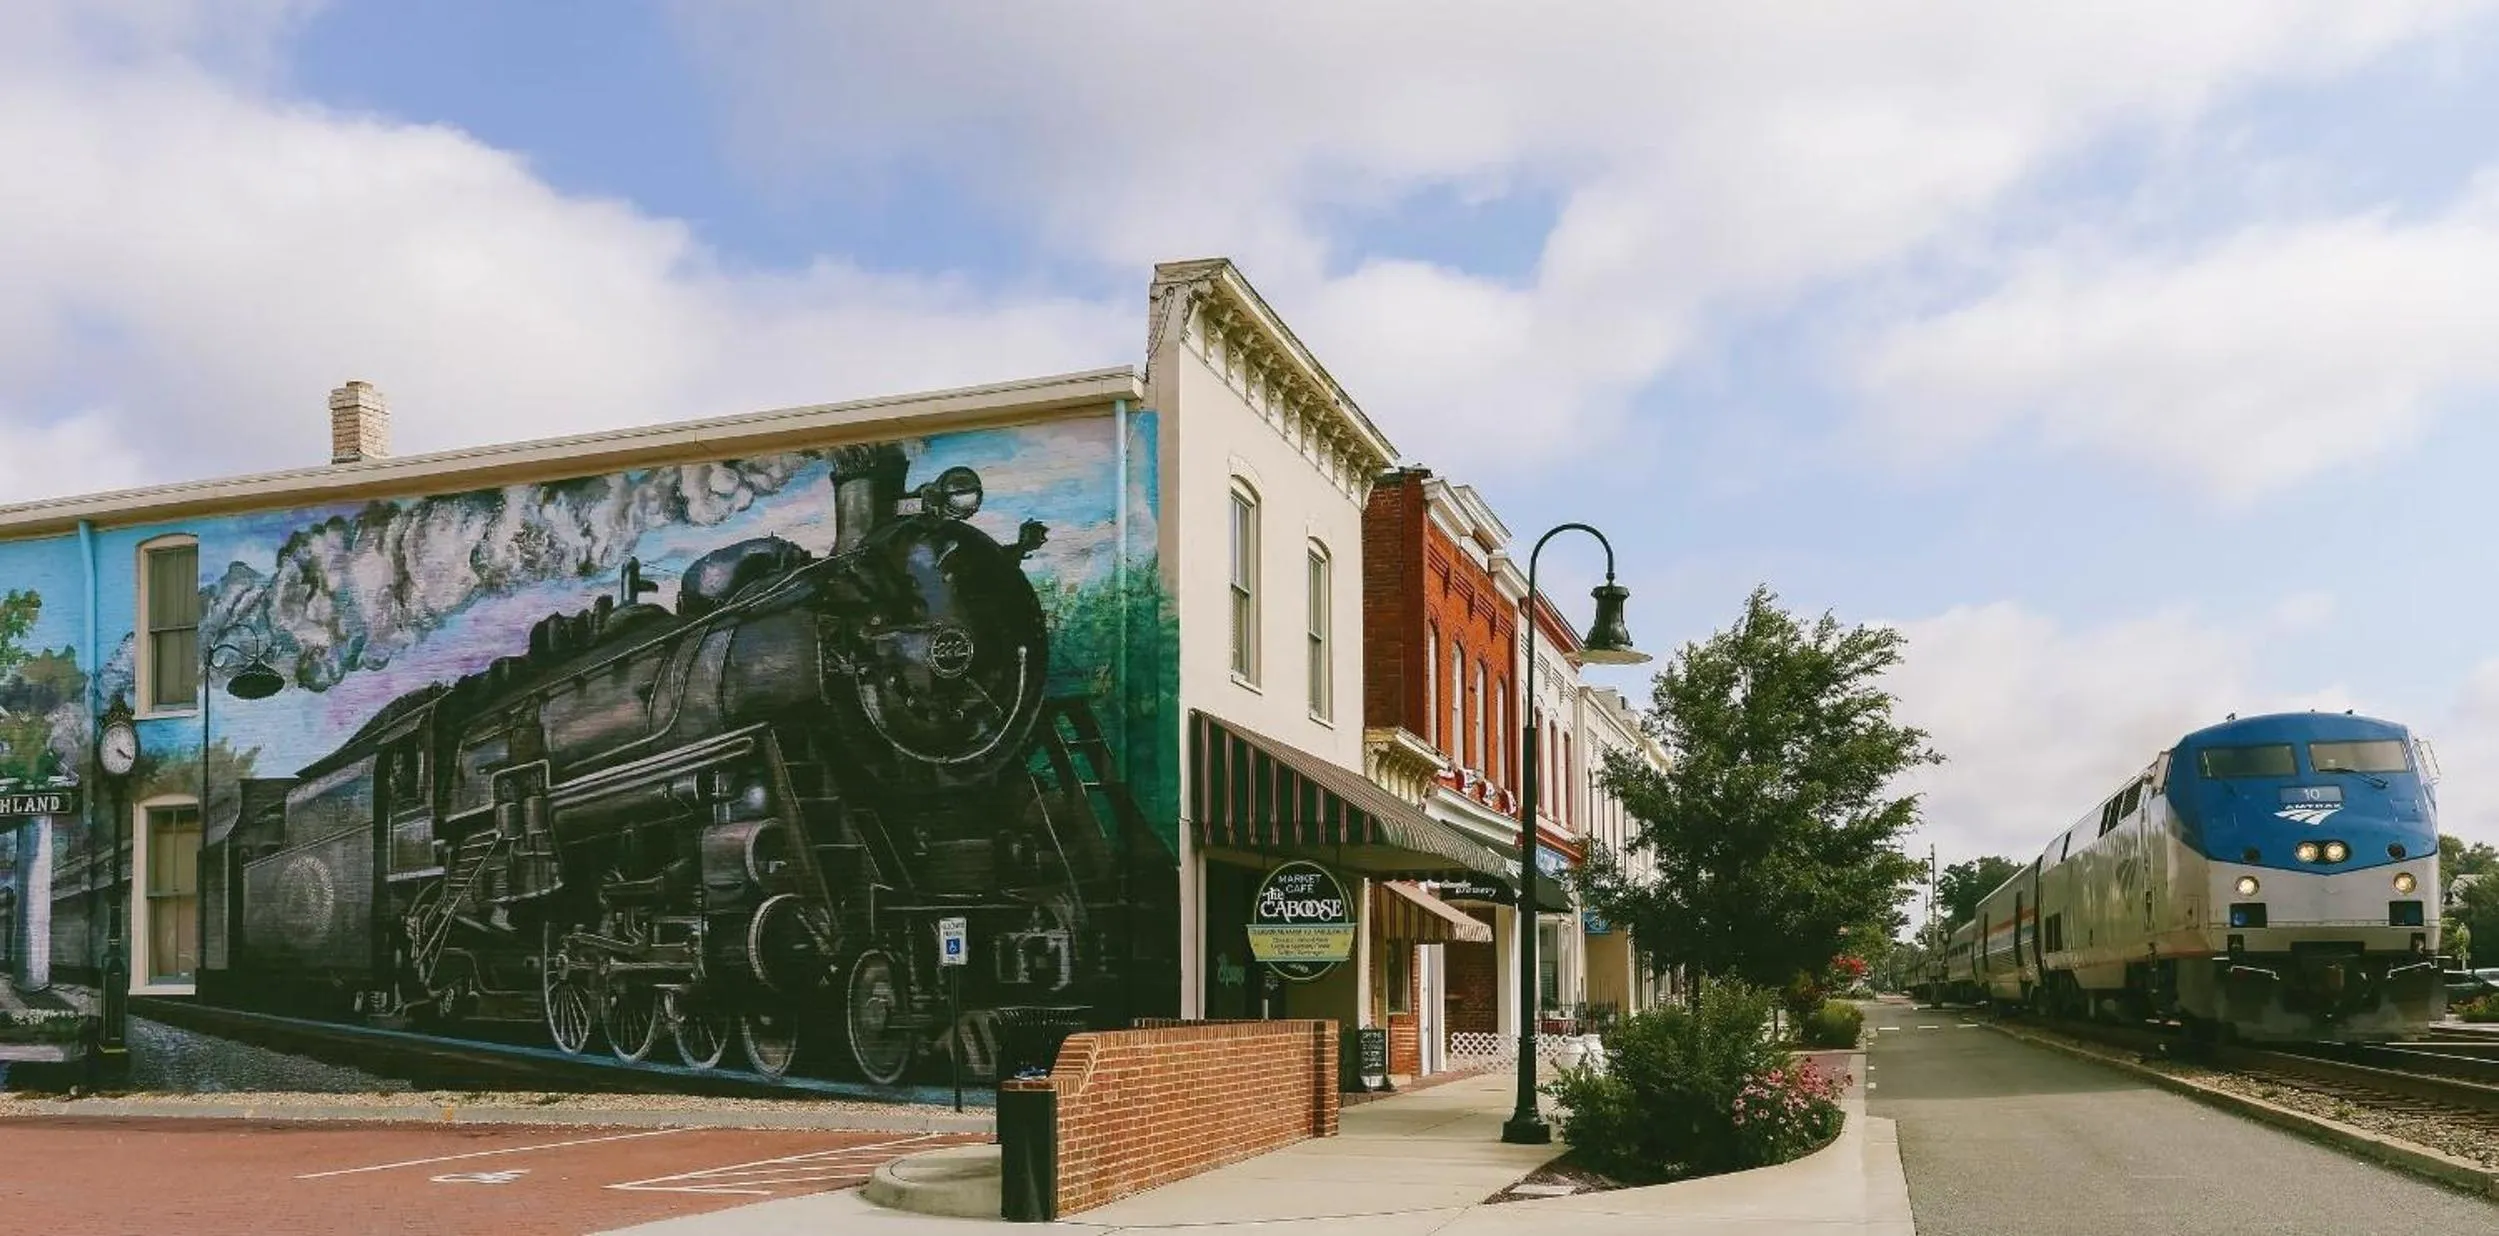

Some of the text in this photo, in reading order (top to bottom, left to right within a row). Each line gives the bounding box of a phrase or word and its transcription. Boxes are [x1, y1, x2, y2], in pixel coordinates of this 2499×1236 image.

[2304, 788, 2320, 801] 10
[1279, 874, 1321, 884] MARKET
[1260, 899, 1343, 923] CABOOSE
